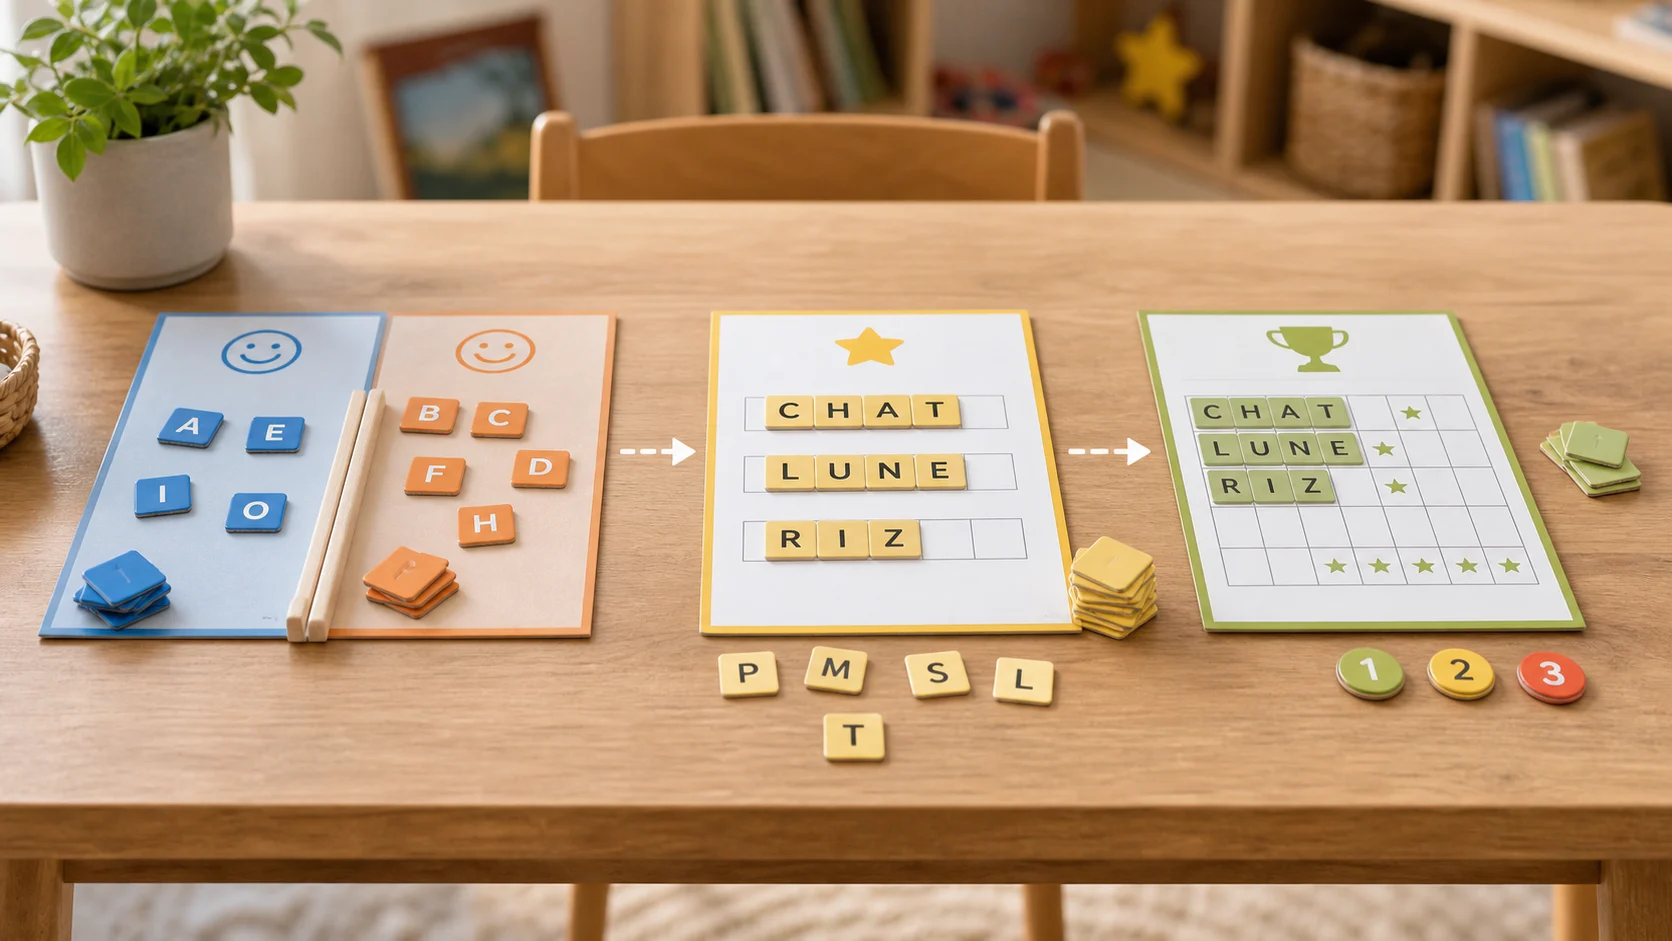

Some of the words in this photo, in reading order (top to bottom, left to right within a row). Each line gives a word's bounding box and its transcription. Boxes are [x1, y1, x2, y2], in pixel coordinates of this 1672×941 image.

[418, 404, 440, 421] B
[488, 409, 510, 426] C
[778, 401, 943, 418] CHAT
[1203, 404, 1333, 419] CHAT
[175, 417, 198, 434] A
[265, 423, 285, 440] E
[1212, 440, 1348, 456] LUNE
[424, 464, 446, 482] F
[528, 457, 552, 475] D
[782, 461, 949, 480] LUNE
[159, 485, 165, 502] I
[1221, 477, 1321, 493] RIZ
[242, 501, 269, 520] O
[473, 513, 497, 533] H
[781, 528, 903, 547] RIZ
[738, 662, 758, 683] P
[821, 657, 850, 679] M
[927, 662, 948, 683] S
[1359, 657, 1378, 680] 1
[1450, 658, 1473, 680] 2
[1539, 661, 1565, 685] 3
[1015, 668, 1033, 689] L
[842, 724, 864, 746] T
